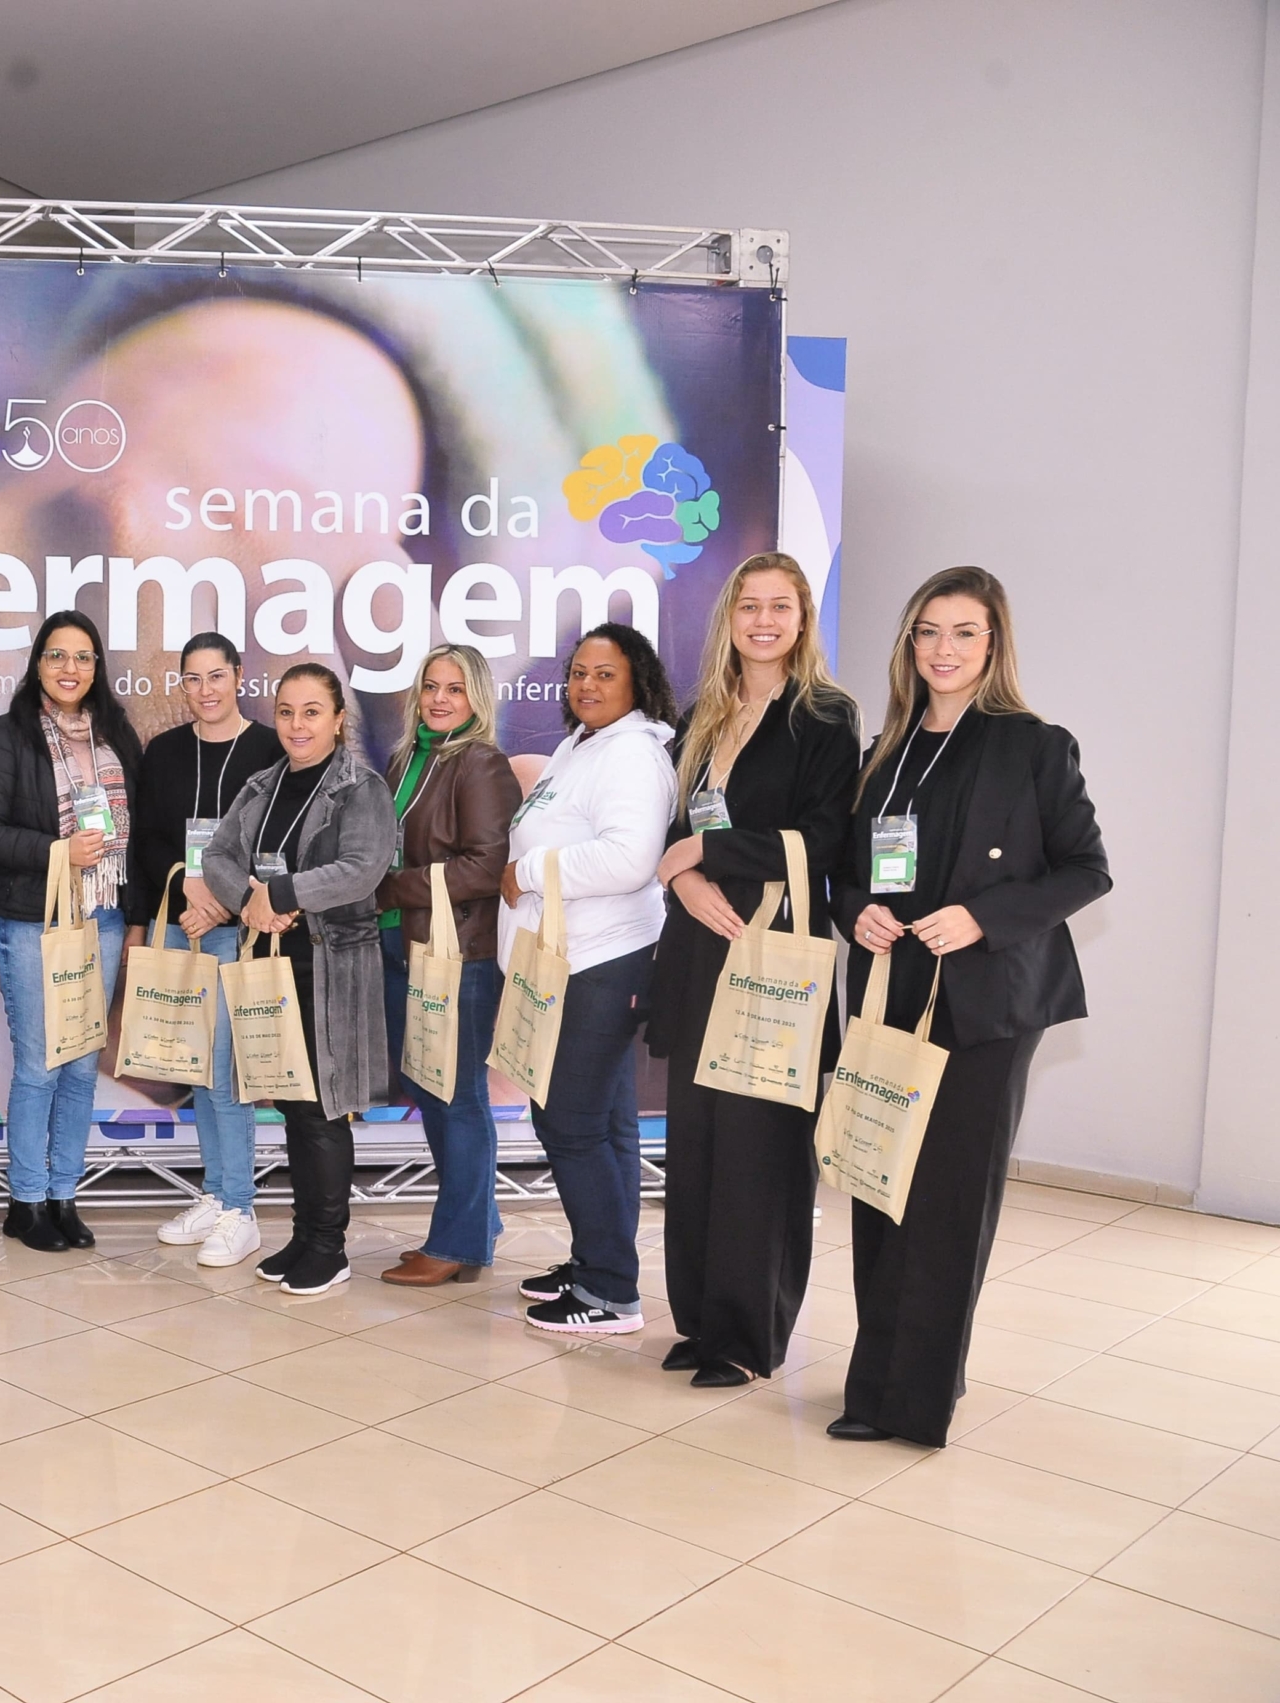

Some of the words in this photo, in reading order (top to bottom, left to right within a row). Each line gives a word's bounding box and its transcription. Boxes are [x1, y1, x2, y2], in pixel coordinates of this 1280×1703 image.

[2, 398, 127, 472] 50
[62, 427, 120, 446] anos
[164, 486, 430, 537] semana
[460, 477, 539, 538] da
[115, 669, 152, 696] do
[758, 975, 787, 985] semana
[788, 980, 799, 988] da
[836, 1066, 910, 1108] Enfermagem
